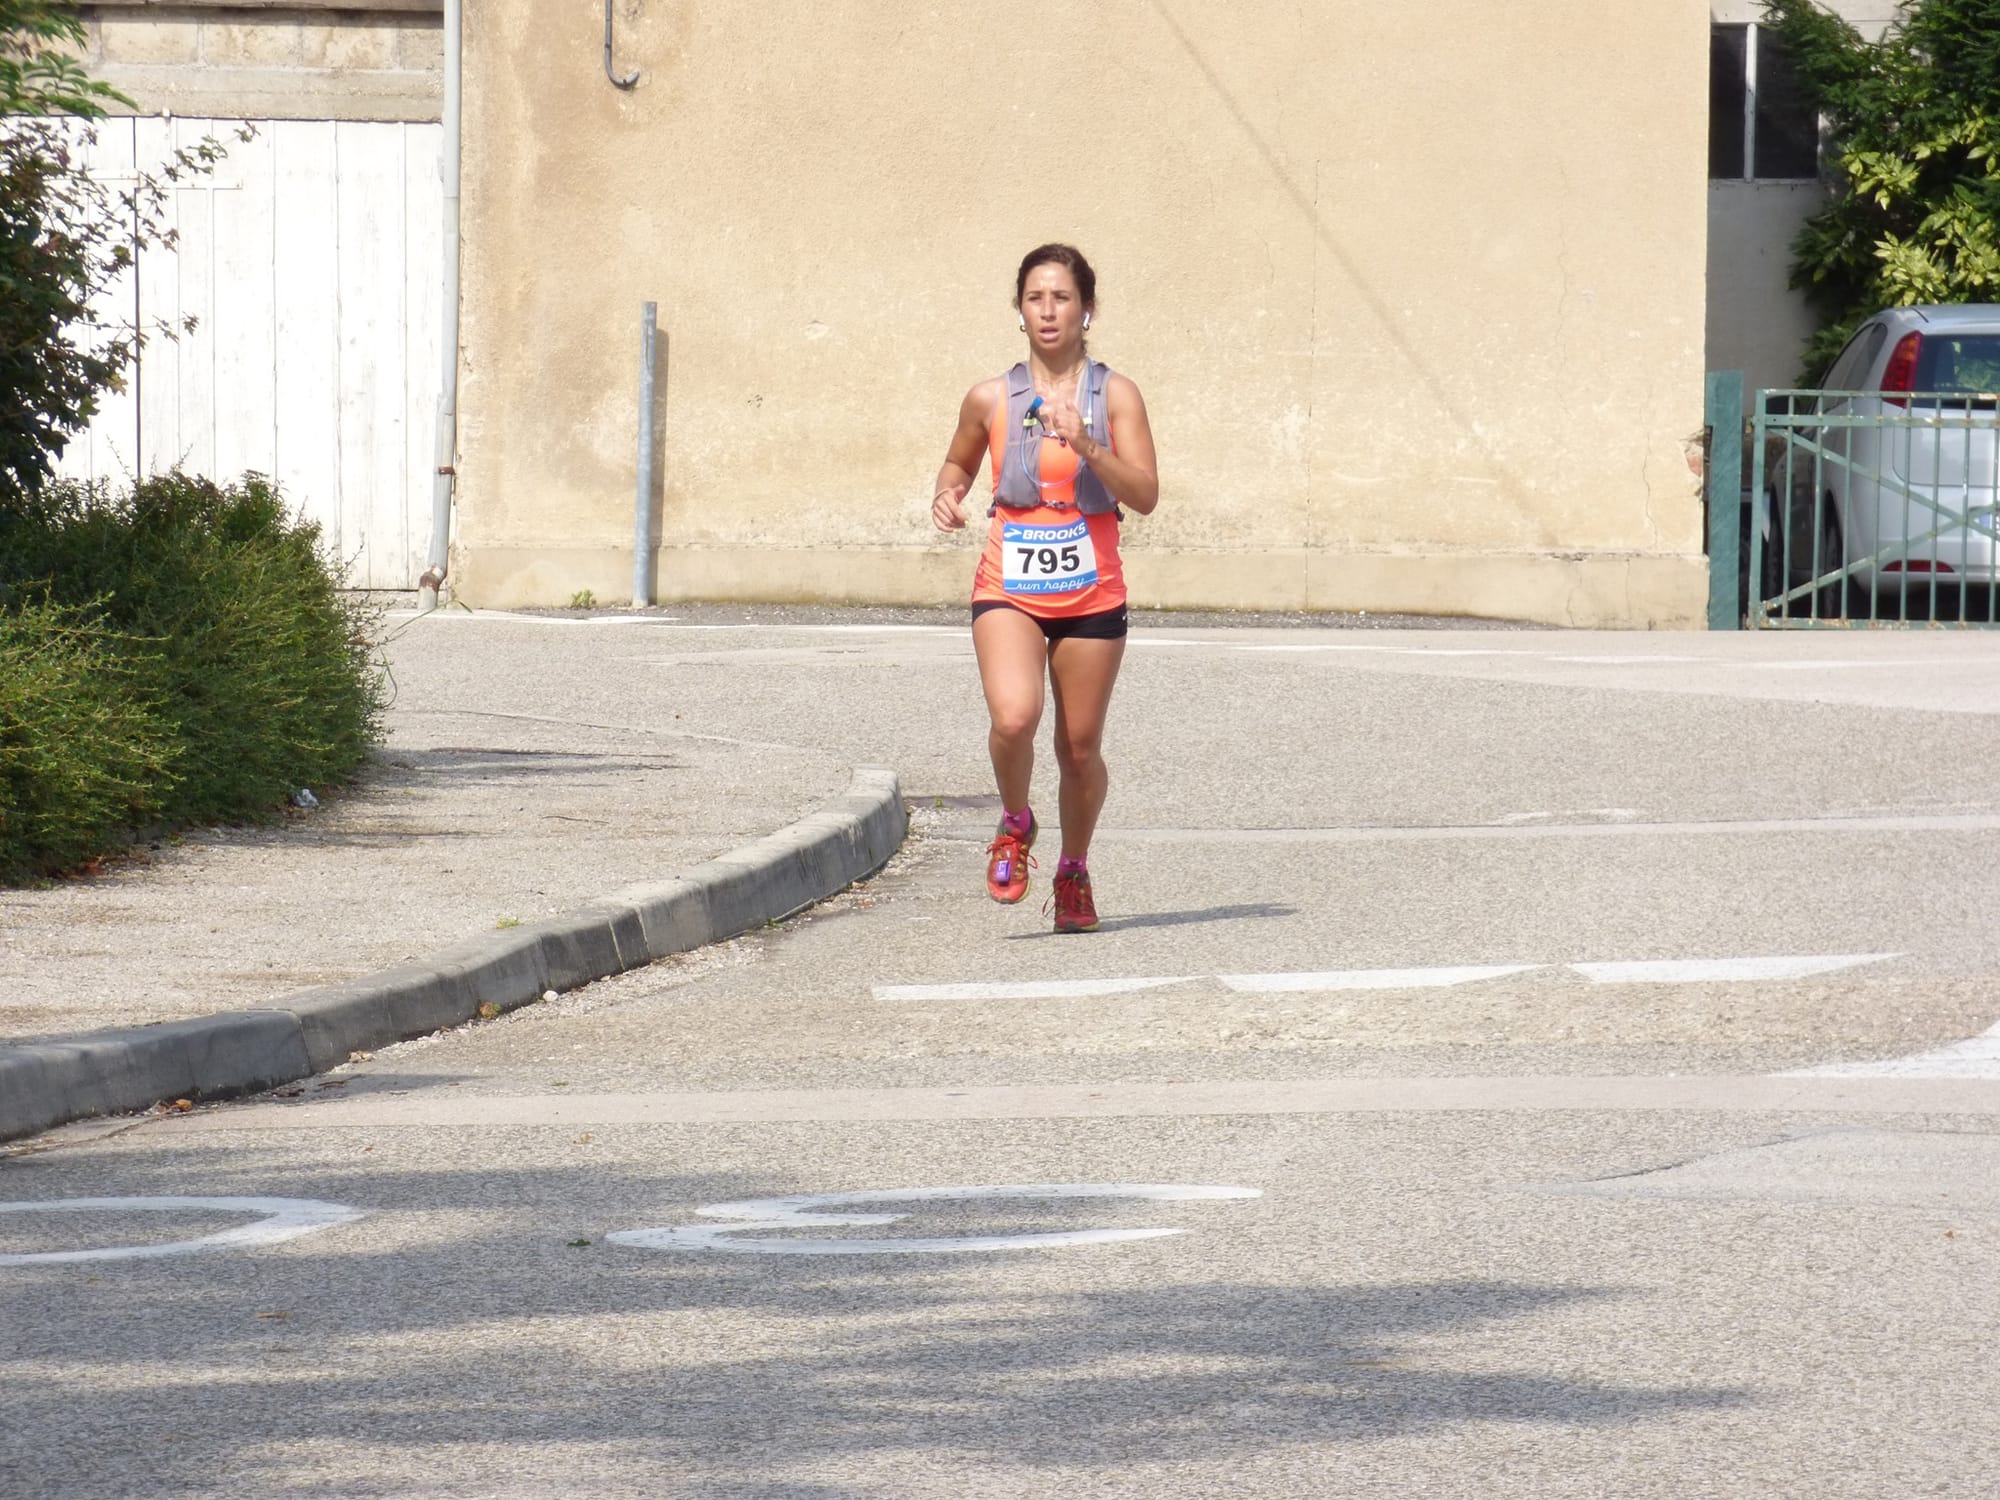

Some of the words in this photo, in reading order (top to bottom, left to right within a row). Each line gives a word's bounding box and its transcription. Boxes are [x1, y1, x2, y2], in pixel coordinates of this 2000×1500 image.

[1022, 522, 1086, 540] BROOKS
[1017, 545, 1080, 574] 795
[1015, 582, 1040, 590] run
[1043, 577, 1085, 591] happy
